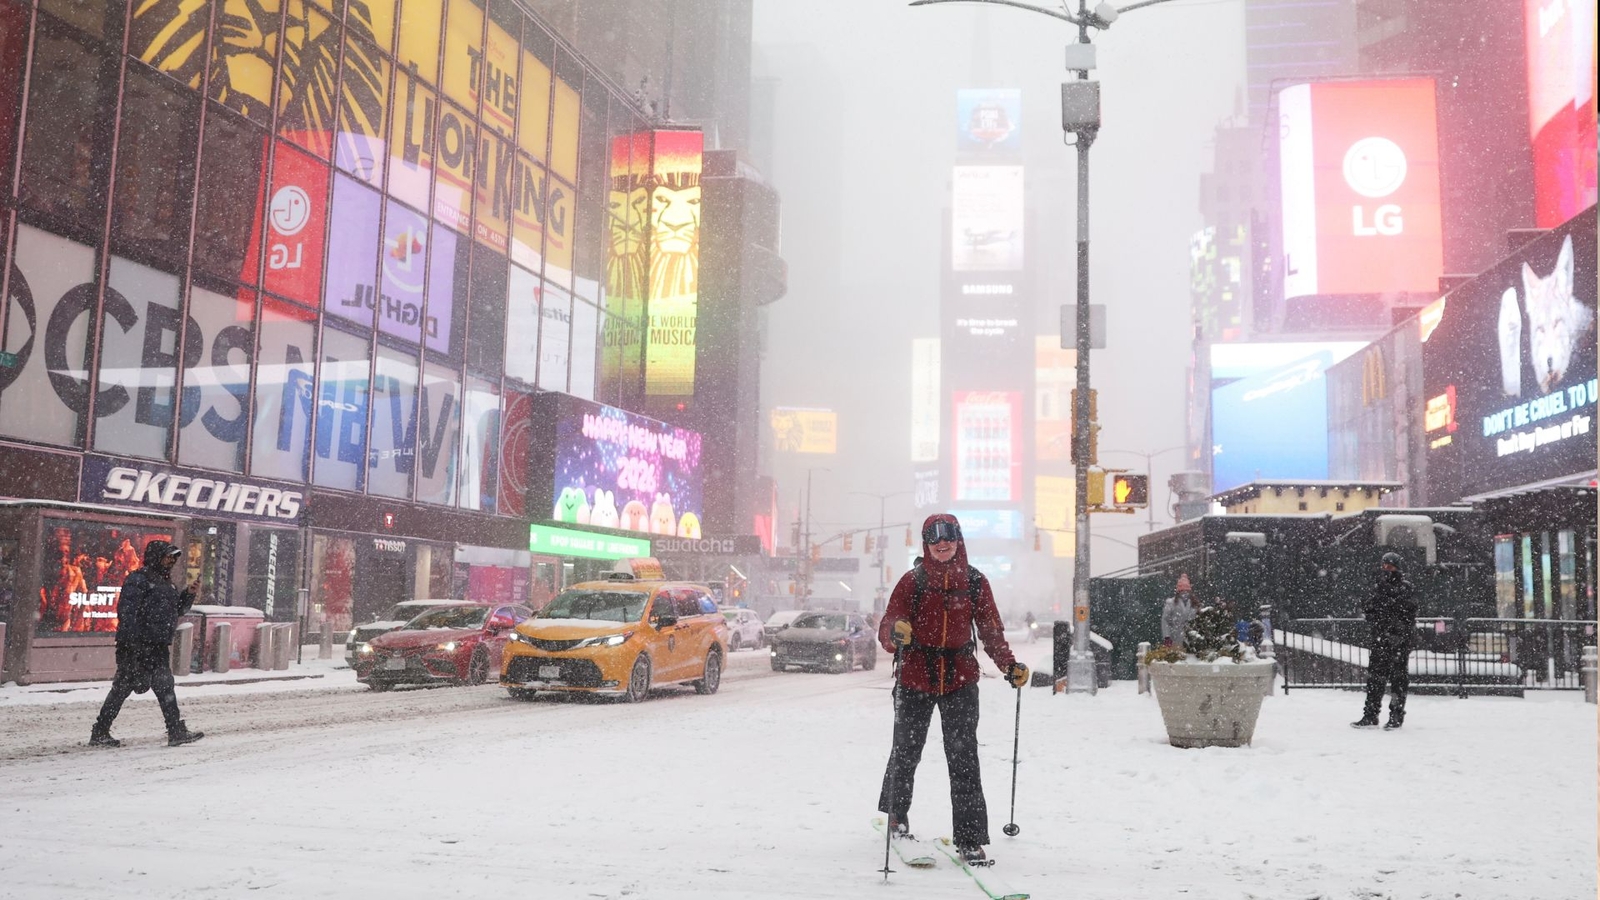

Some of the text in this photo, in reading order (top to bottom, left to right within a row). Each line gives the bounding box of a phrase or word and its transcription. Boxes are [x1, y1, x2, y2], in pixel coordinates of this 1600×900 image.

[467, 45, 516, 118] THE
[402, 59, 565, 236] LION KING
[437, 202, 469, 227] ENTRANCE
[477, 225, 488, 238] ON
[1352, 204, 1403, 236] LG
[962, 284, 1013, 295] SAMSUNG
[660, 316, 695, 328] WORLD
[45, 282, 456, 479] CBS NEW
[1482, 406, 1514, 437] DON'T
[1514, 402, 1529, 427] BE
[1529, 390, 1568, 423] CRUEL
[1568, 383, 1587, 409] TO
[582, 412, 688, 461] HAPPY NEW YEAR
[103, 466, 303, 519] SKECHERS
[616, 455, 658, 493] 2026
[655, 536, 722, 553] swatch
[265, 532, 278, 617] SKECHERS
[68, 592, 116, 608] SILENT
